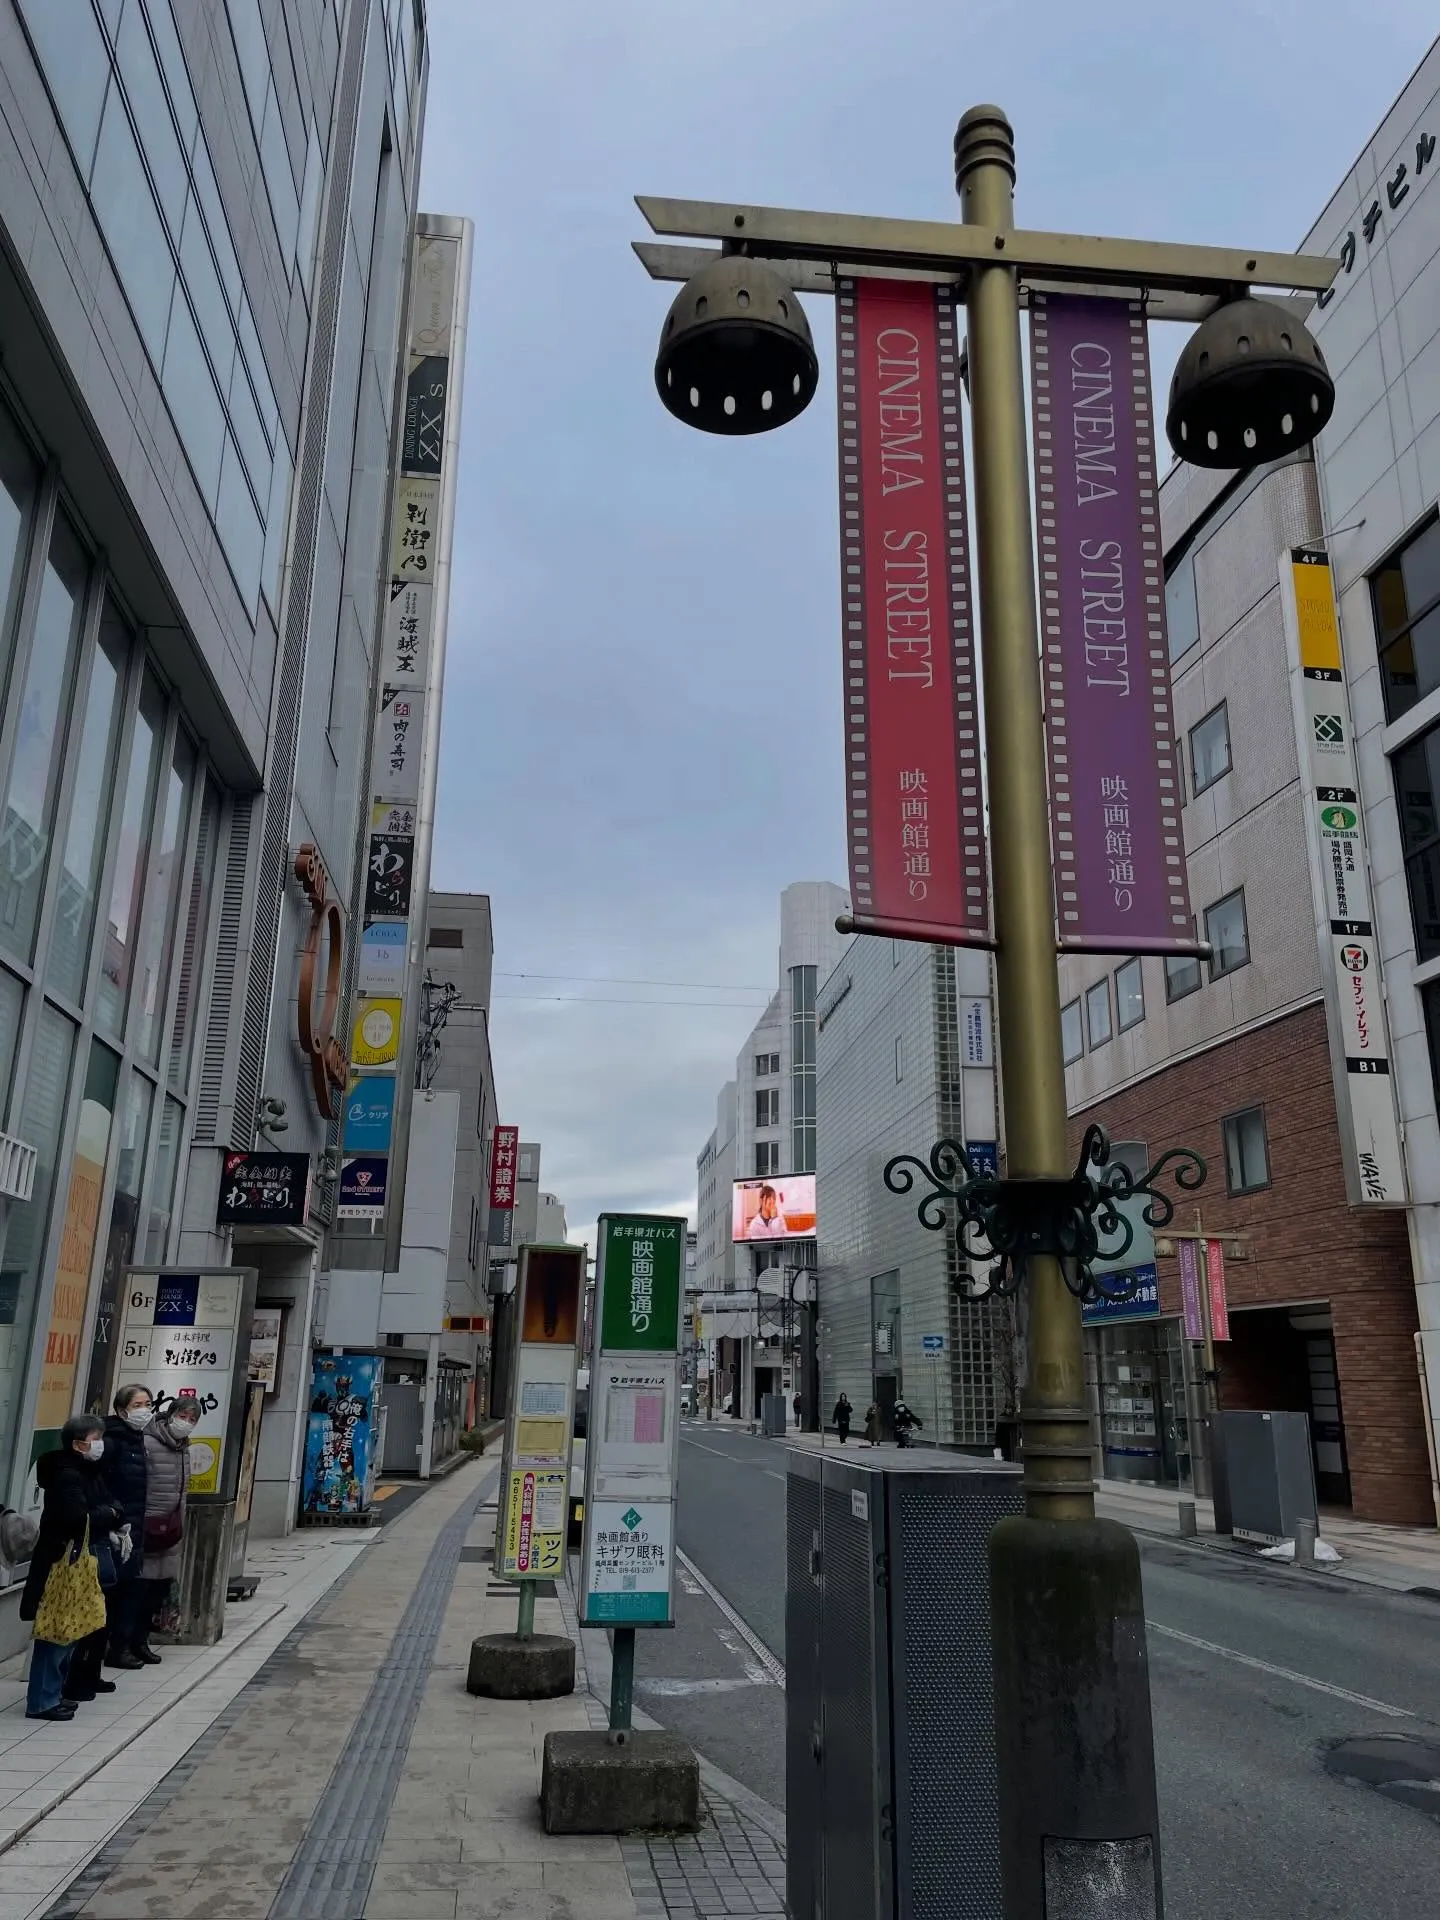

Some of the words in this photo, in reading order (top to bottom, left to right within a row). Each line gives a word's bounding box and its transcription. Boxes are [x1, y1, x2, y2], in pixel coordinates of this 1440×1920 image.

[875, 327, 926, 498] CINEMA
[1069, 341, 1119, 507] CINEMA
[405, 428, 415, 459] DINING
[1302, 555, 1317, 564] 4F
[392, 584, 402, 592] 4F
[883, 528, 934, 689] STREET
[1079, 539, 1130, 697] STREET
[1315, 671, 1330, 680] 3F
[384, 692, 394, 701] 4F
[1328, 790, 1344, 800] 2F
[899, 768, 929, 903] 映画館通り
[1100, 774, 1136, 912] 映画館通り
[1343, 841, 1356, 872] 盛岡大通
[1345, 924, 1359, 934] 1F
[1360, 1061, 1377, 1072] B1
[495, 1132, 515, 1203] 野村證券
[613, 1226, 676, 1239] 岩手県北バス
[629, 1240, 655, 1333] 映画館通り
[131, 1291, 155, 1308] 6F
[173, 1332, 211, 1343] 日本料理
[45, 1332, 77, 1364] HAM
[124, 1341, 148, 1357] 5F
[620, 1377, 665, 1385] 岩手県北バス
[597, 1531, 649, 1543] 映画館通り
[596, 1545, 665, 1559] キザワ眼科
